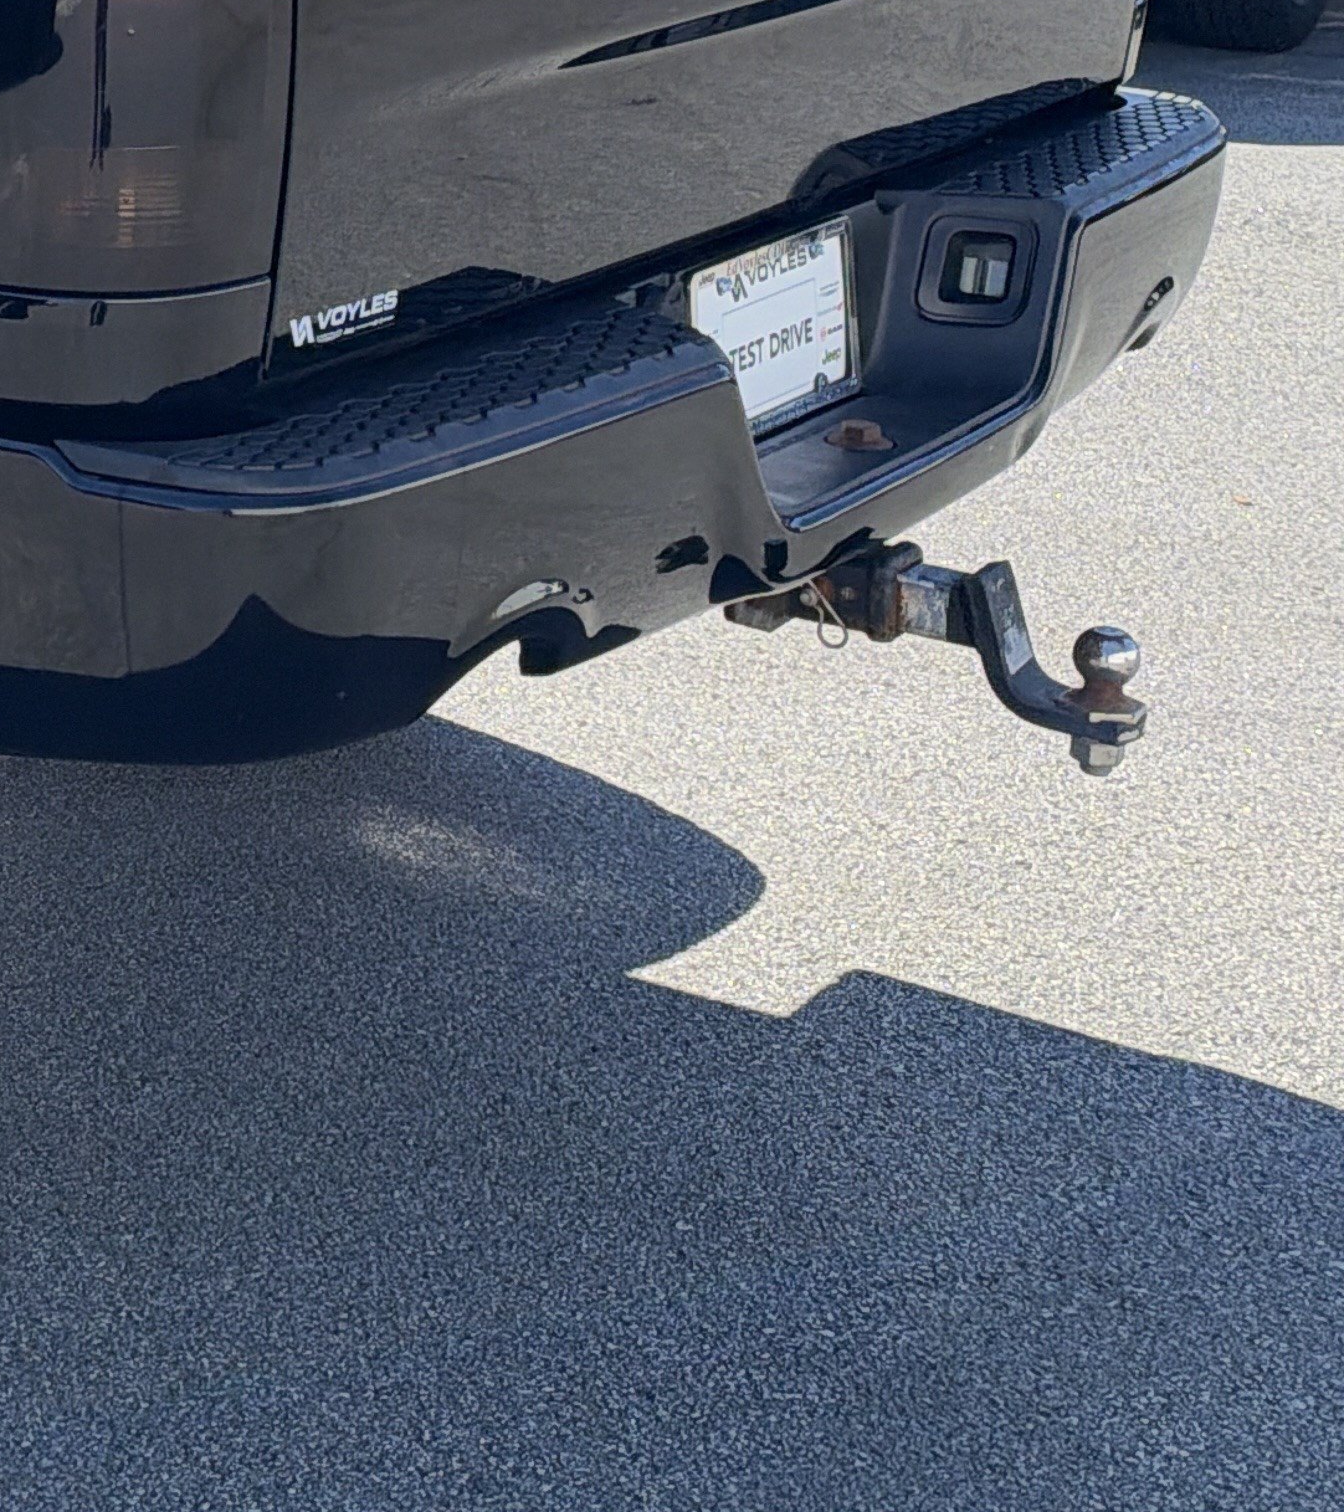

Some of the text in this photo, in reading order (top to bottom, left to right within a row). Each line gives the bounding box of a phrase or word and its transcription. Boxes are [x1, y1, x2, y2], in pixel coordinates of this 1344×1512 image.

[743, 244, 808, 287] VOYLES
[317, 289, 398, 330] VOYLES
[729, 317, 813, 372] TEST DRIVE
